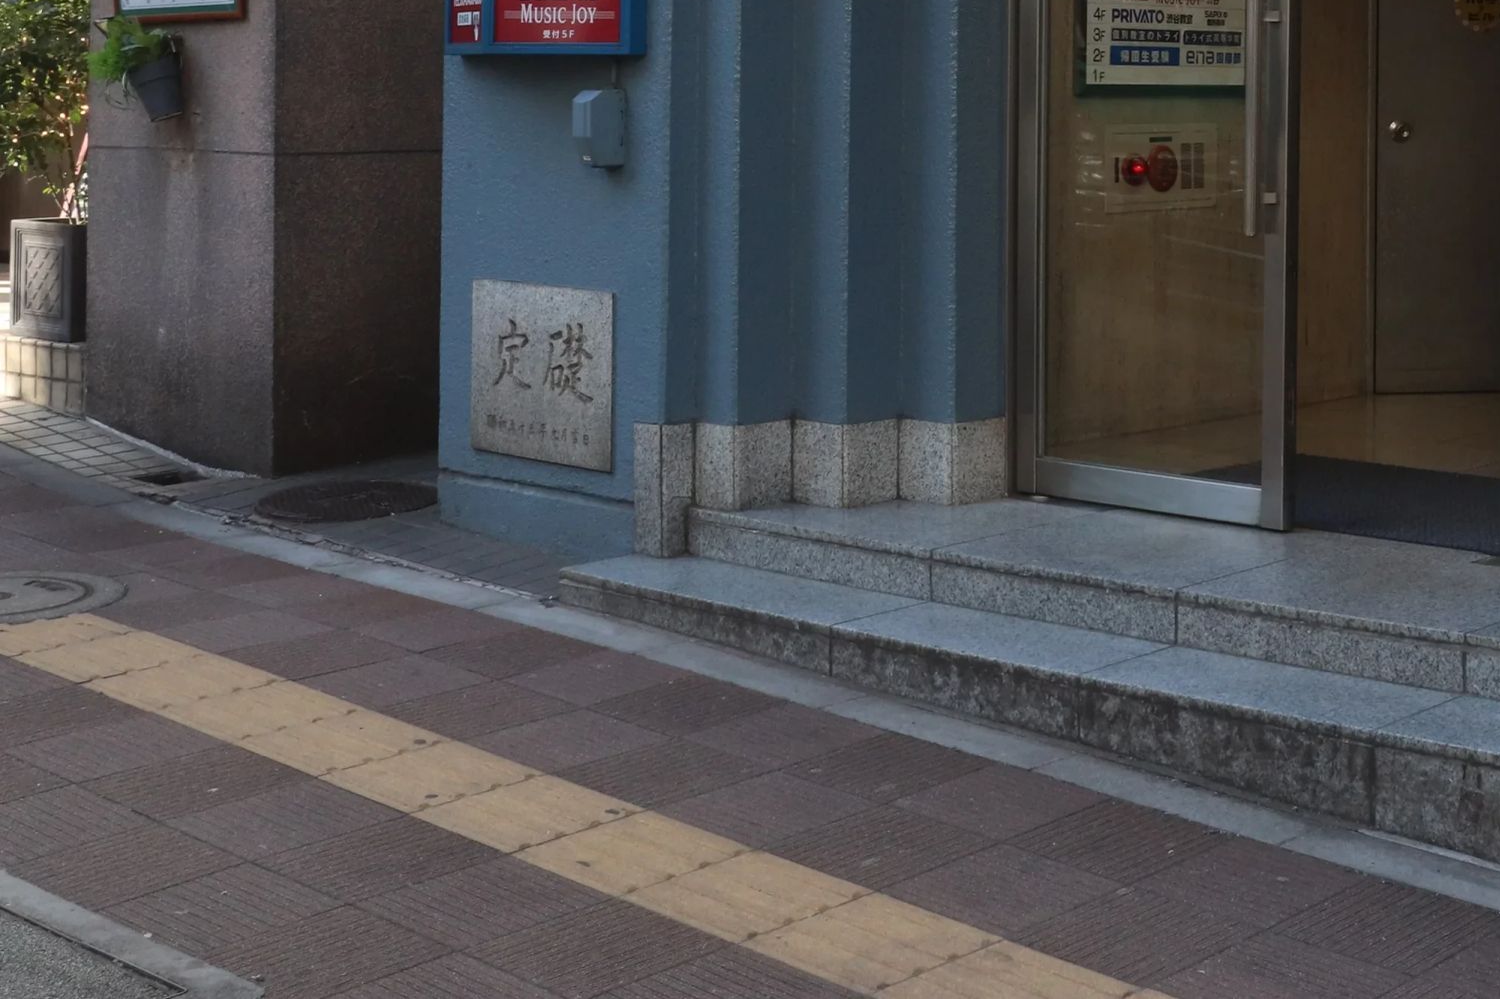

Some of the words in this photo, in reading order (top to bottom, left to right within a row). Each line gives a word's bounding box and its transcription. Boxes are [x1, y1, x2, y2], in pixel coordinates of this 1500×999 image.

[1093, 8, 1106, 22] 4F
[1111, 8, 1164, 24] PRIVATO
[1092, 27, 1106, 41] 3F
[1112, 30, 1180, 42] 個別教室のトライ
[1092, 47, 1106, 62] 2F
[1092, 69, 1105, 83] 1F
[492, 317, 594, 403] 定礎
